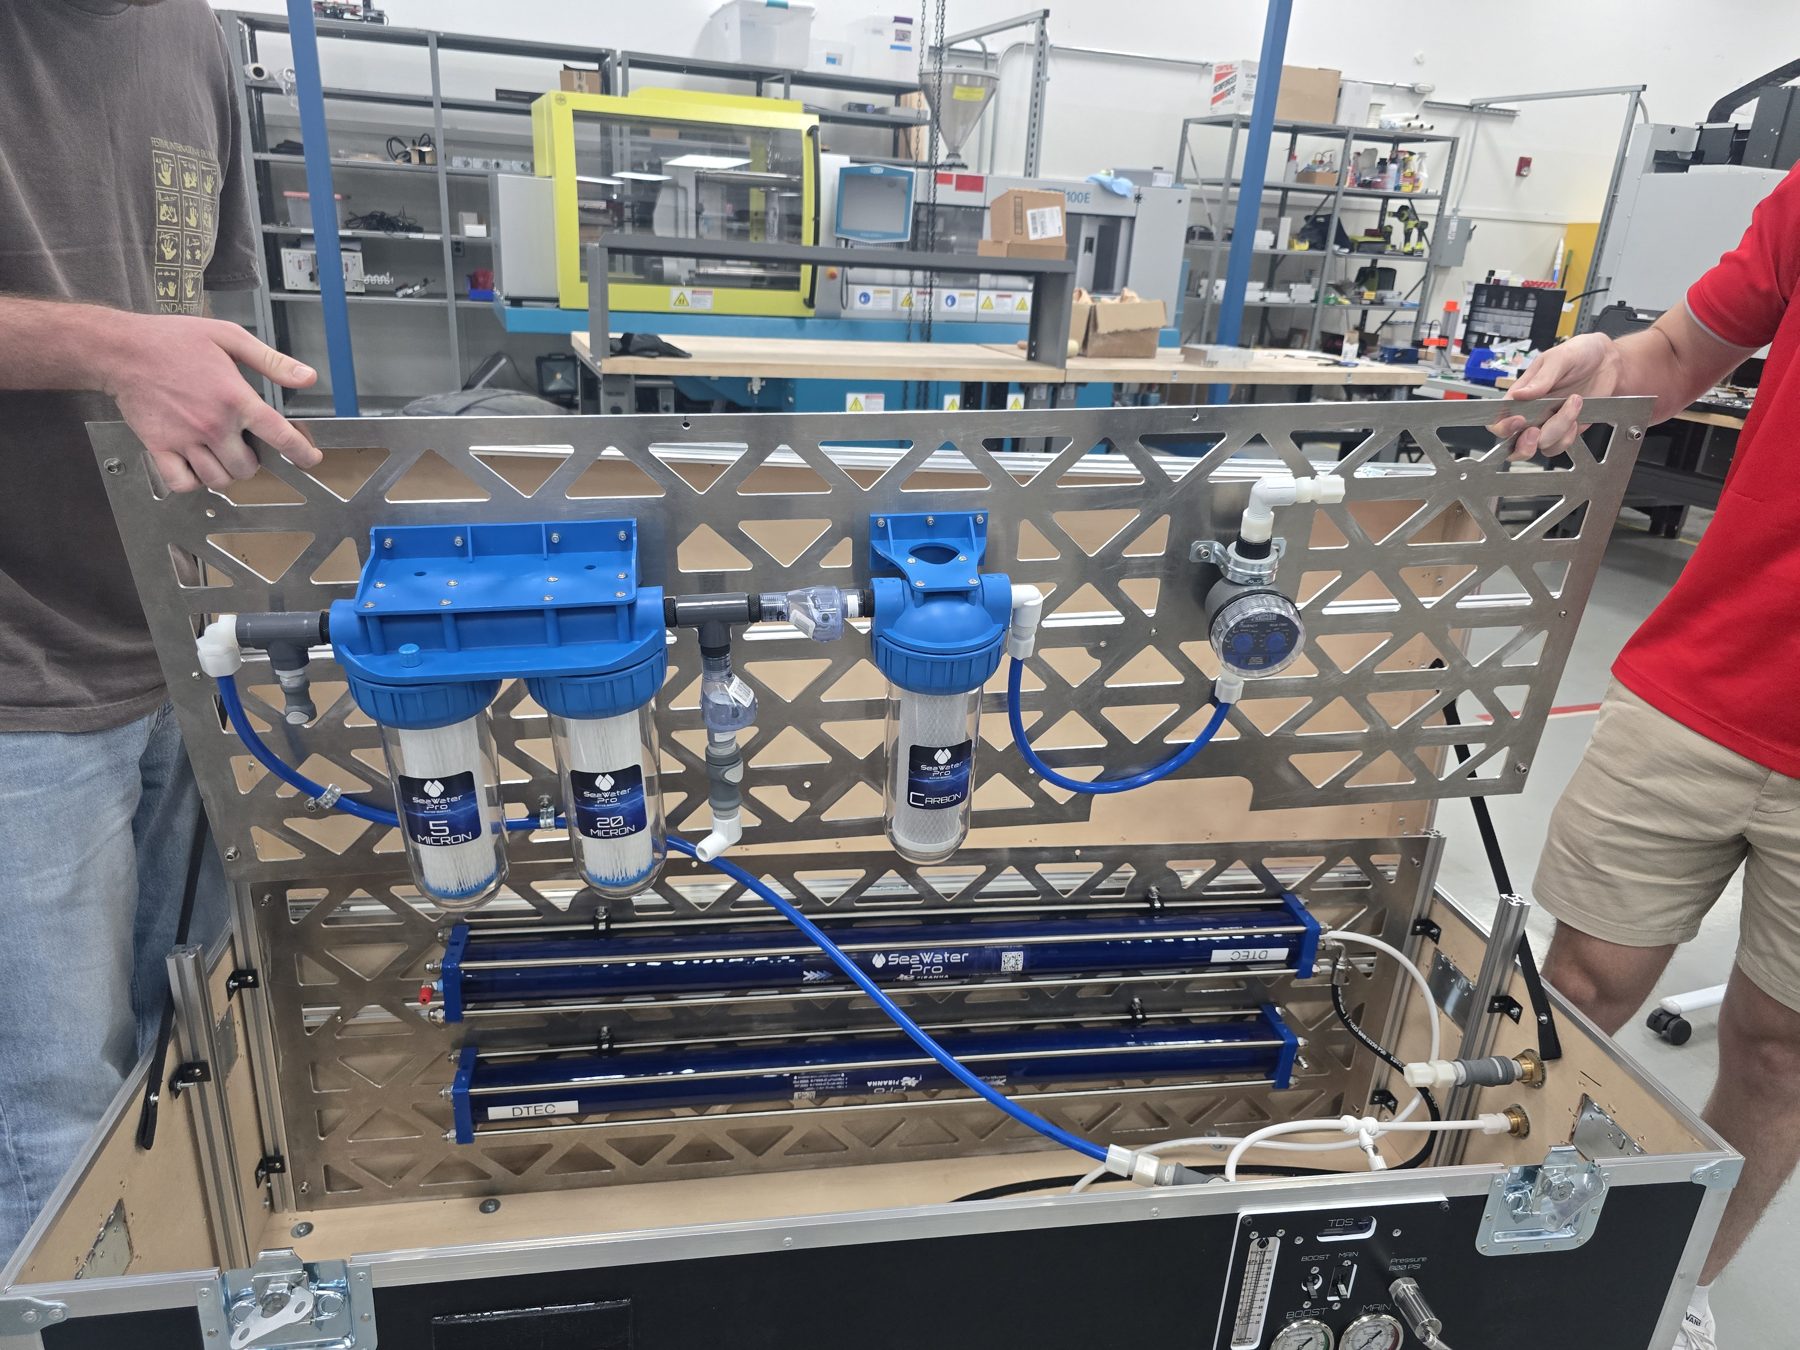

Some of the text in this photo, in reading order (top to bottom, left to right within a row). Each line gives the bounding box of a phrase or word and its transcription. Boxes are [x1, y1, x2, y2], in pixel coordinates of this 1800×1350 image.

[1066, 191, 1090, 204] 100E
[920, 761, 963, 771] SeaWater
[584, 788, 632, 798] SeaWater
[412, 794, 463, 805] SeaWater
[596, 816, 624, 828] 20
[428, 820, 450, 836] 5
[590, 824, 636, 837] MICRON
[416, 832, 472, 845] MICRON
[888, 952, 969, 965] SeaWater
[1230, 950, 1268, 961] DTEC
[910, 964, 943, 975] Pro
[512, 1104, 556, 1116] DTEC
[1328, 1218, 1354, 1227] TDS
[1390, 1256, 1428, 1264] Pressure
[1286, 1307, 1329, 1319] BOOST
[1362, 1303, 1392, 1312] MAIN
